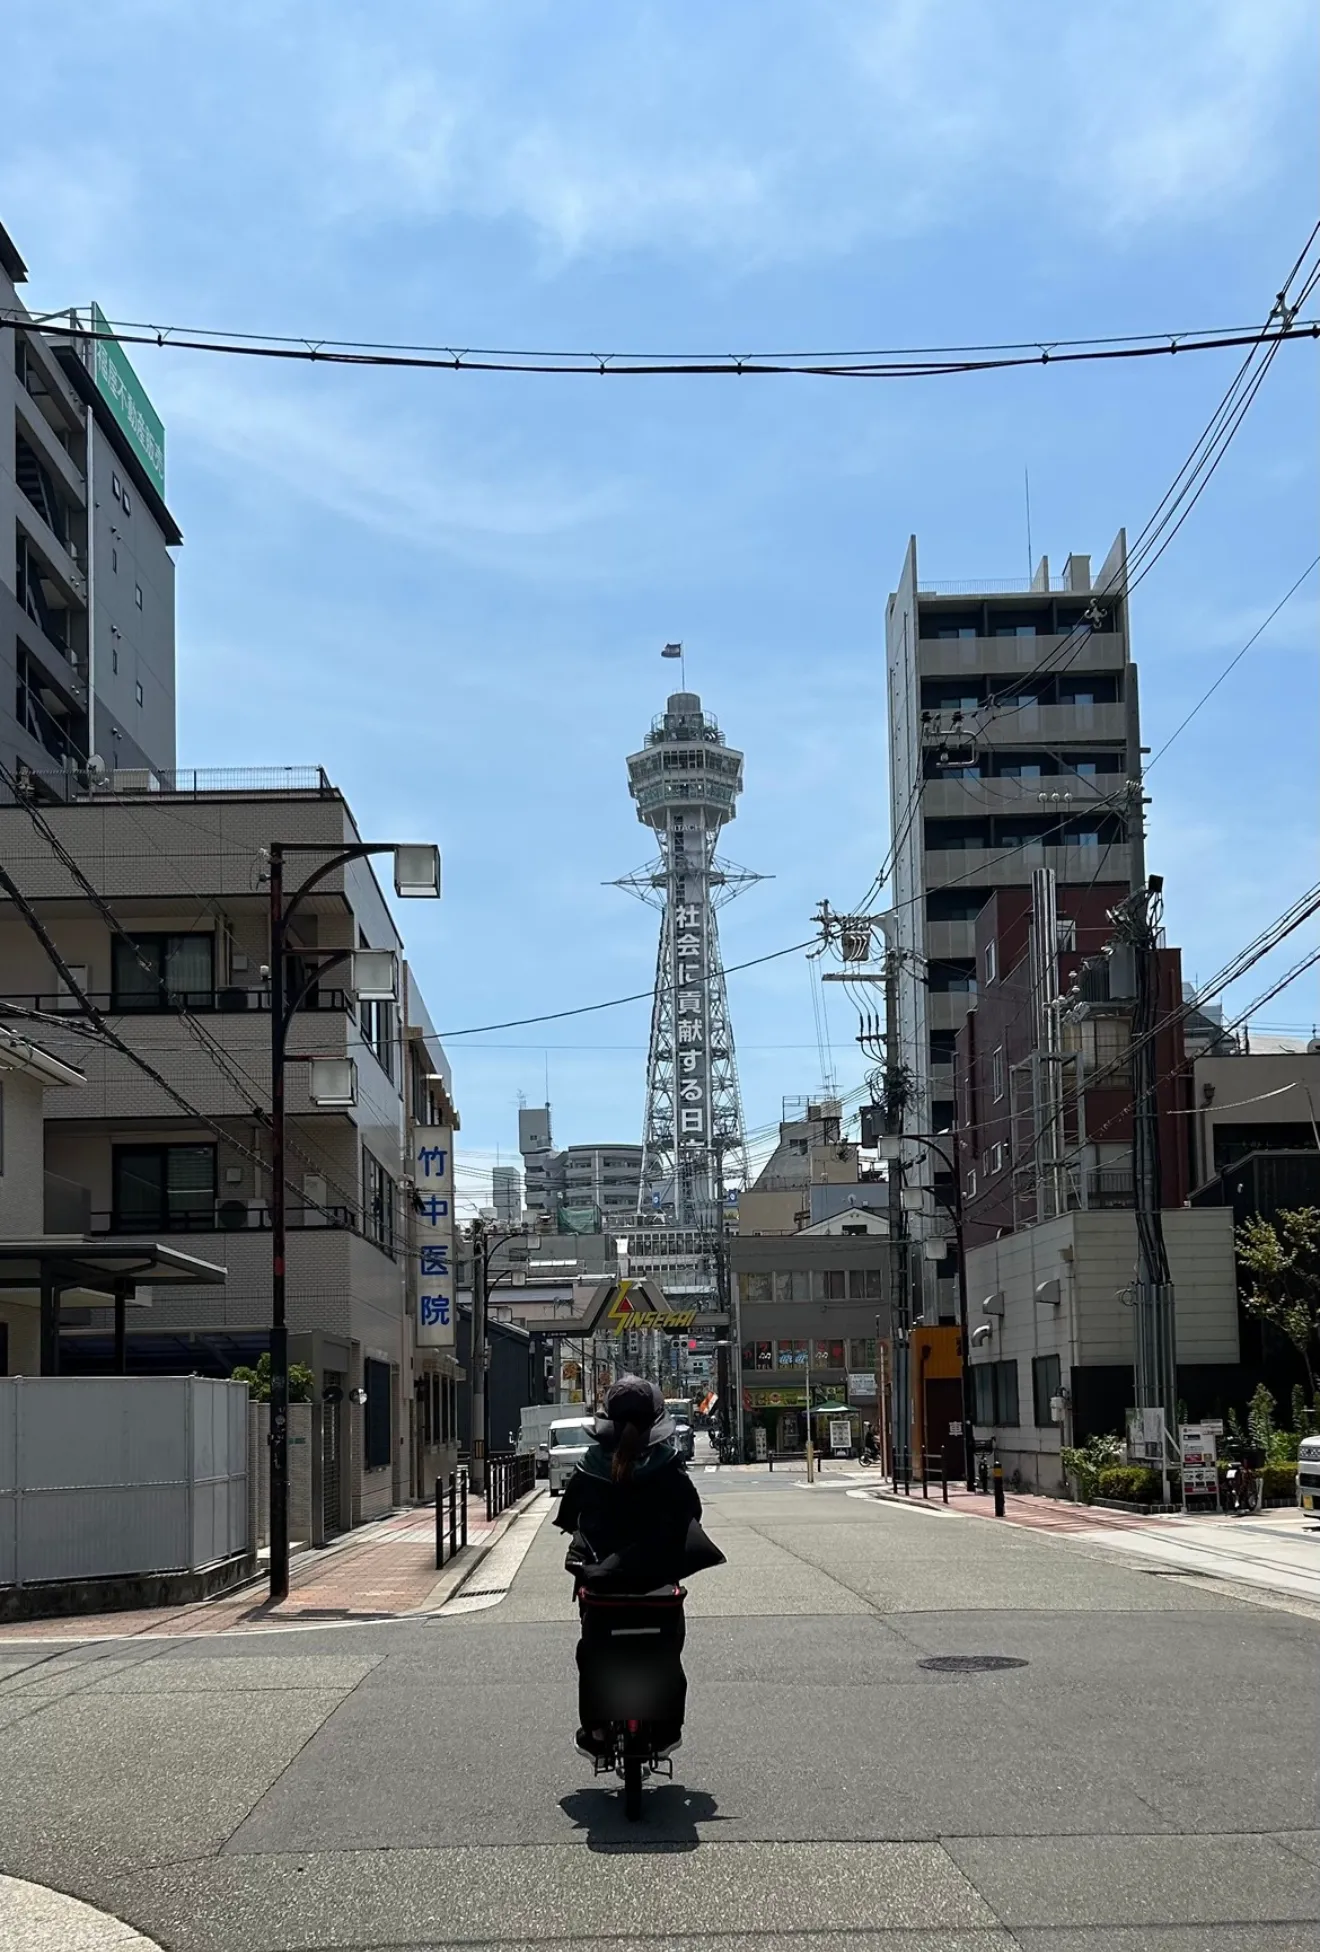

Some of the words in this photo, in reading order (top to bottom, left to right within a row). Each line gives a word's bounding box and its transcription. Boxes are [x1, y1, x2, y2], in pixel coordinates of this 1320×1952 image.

[417, 1146, 450, 1326] 竹中医院
[608, 1281, 697, 1337] SINSEKAI
